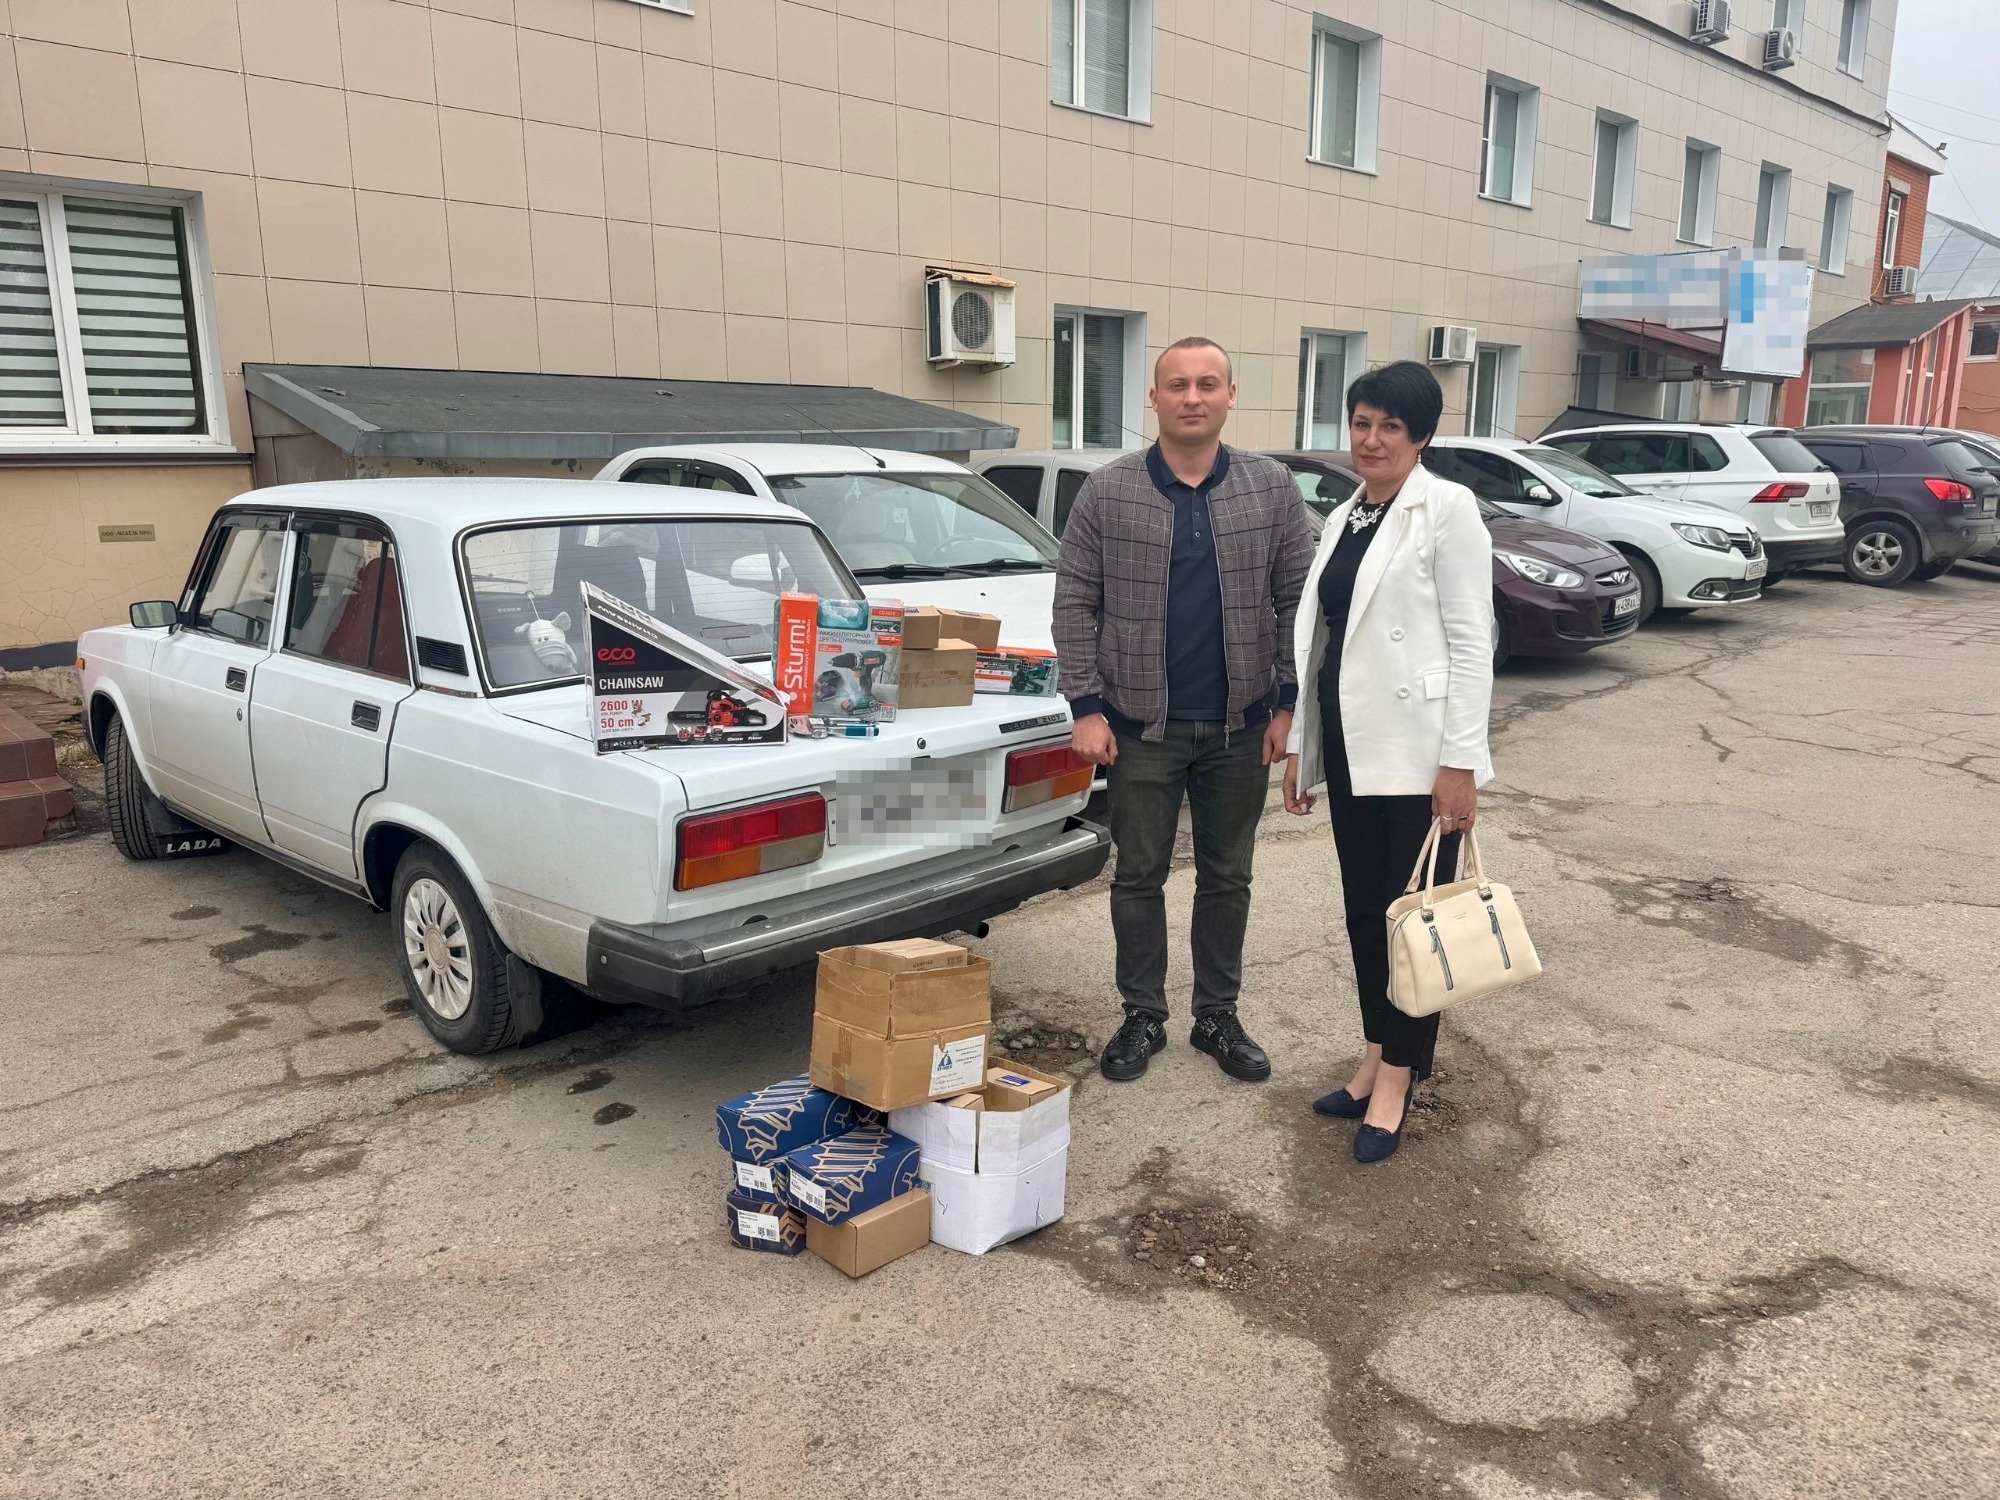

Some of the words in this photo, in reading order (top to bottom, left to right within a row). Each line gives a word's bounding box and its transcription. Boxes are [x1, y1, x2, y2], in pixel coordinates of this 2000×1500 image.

[597, 647, 636, 661] eco
[784, 618, 806, 690] Sturm!
[598, 676, 664, 690] CHAINSAW
[600, 700, 628, 711] 2600
[600, 718, 614, 728] 50
[618, 718, 634, 727] cm
[1007, 720, 1032, 730] LADA
[1042, 714, 1061, 723] 2107
[165, 838, 222, 854] LADA
